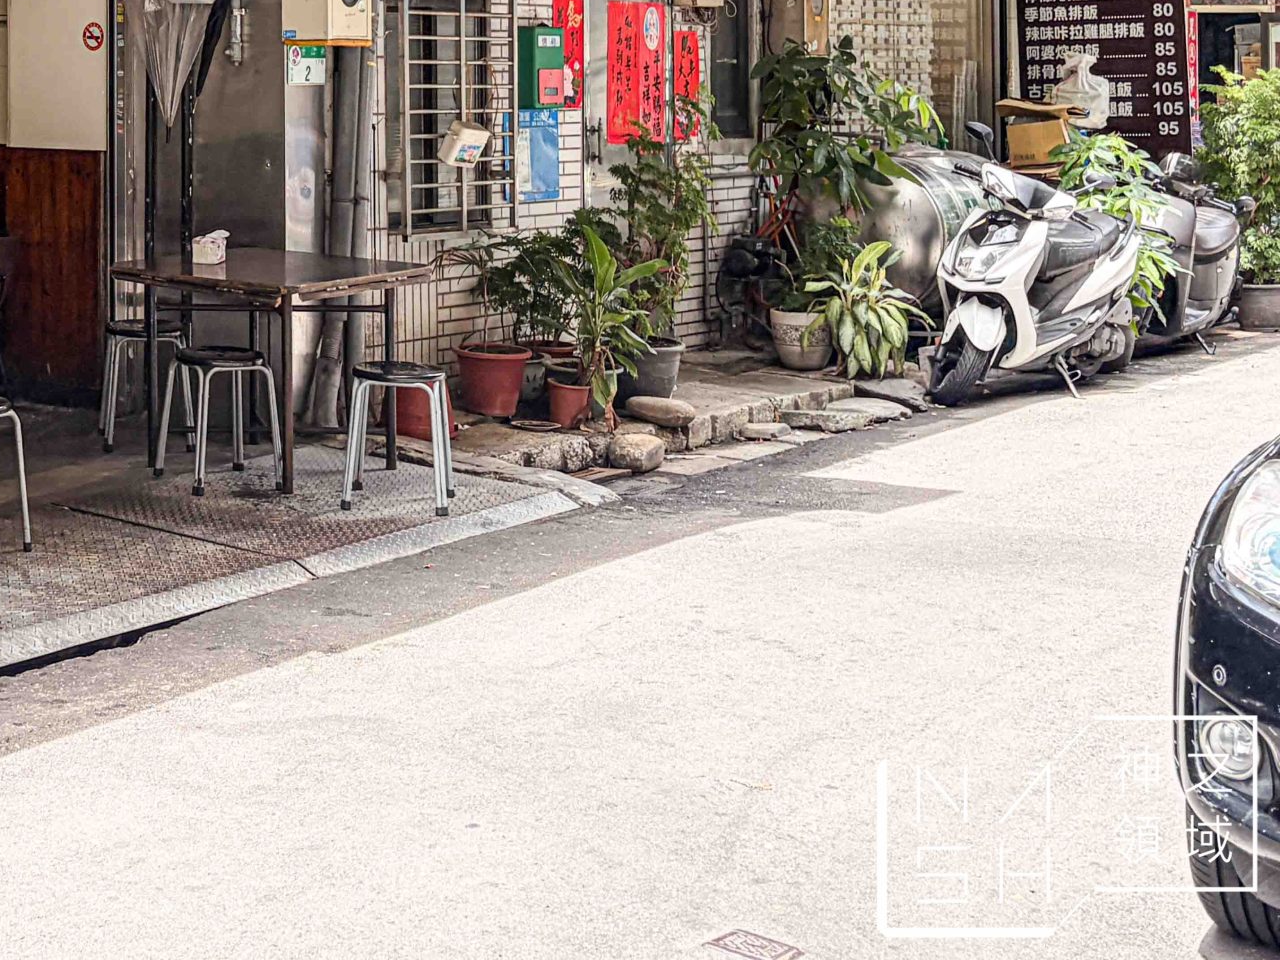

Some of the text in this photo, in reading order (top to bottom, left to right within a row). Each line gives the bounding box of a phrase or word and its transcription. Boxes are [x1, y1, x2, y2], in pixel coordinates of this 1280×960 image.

[1025, 3, 1174, 22] 季節魚排飯 80
[1154, 22, 1175, 37] 80
[1155, 42, 1176, 57] 85
[304, 65, 311, 82] 2
[1156, 62, 1177, 76] 85
[1152, 82, 1184, 96] 105
[1153, 101, 1184, 116] 105
[1158, 121, 1180, 136] 95
